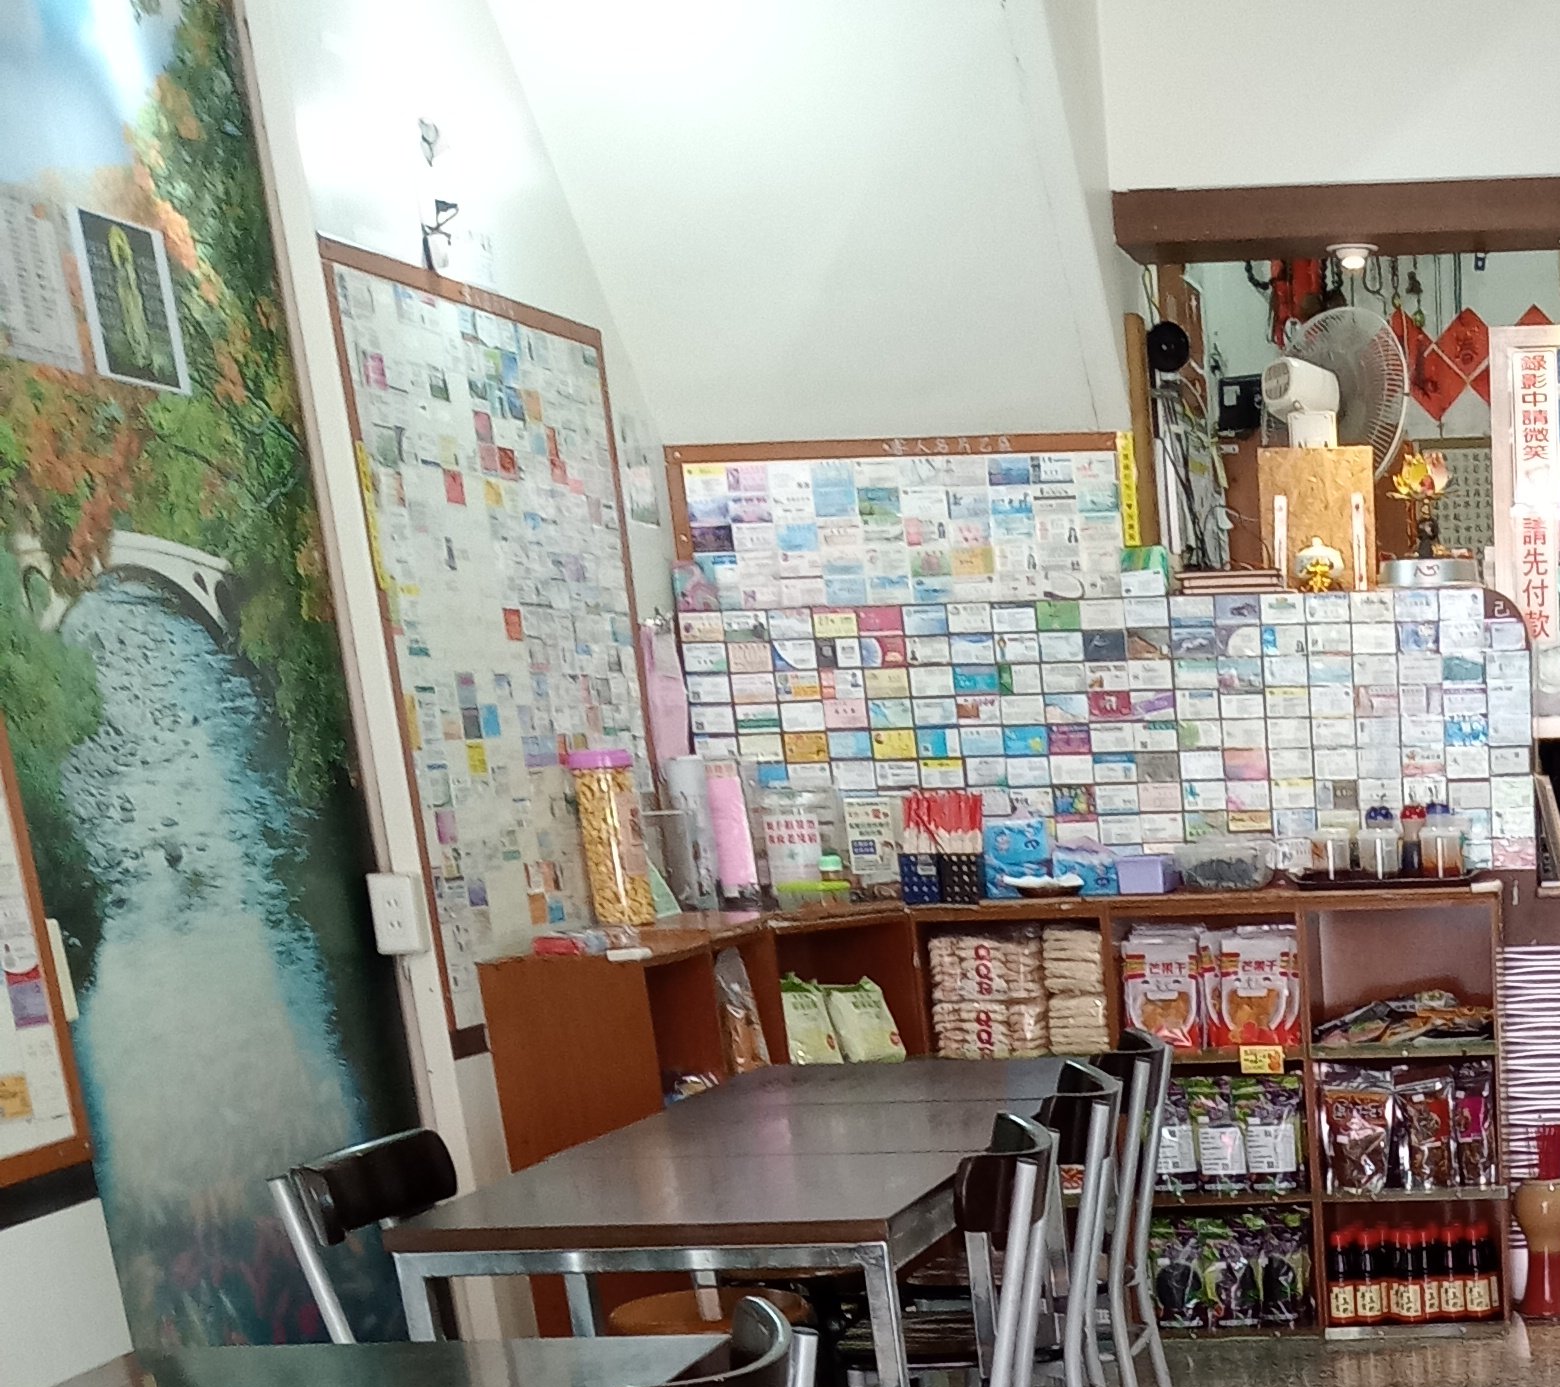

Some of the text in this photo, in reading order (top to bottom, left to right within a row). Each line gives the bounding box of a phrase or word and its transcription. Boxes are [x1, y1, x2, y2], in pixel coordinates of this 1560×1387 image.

[1520, 354, 1550, 461] 錄影中請微笑
[1522, 517, 1550, 639] 請先付款
